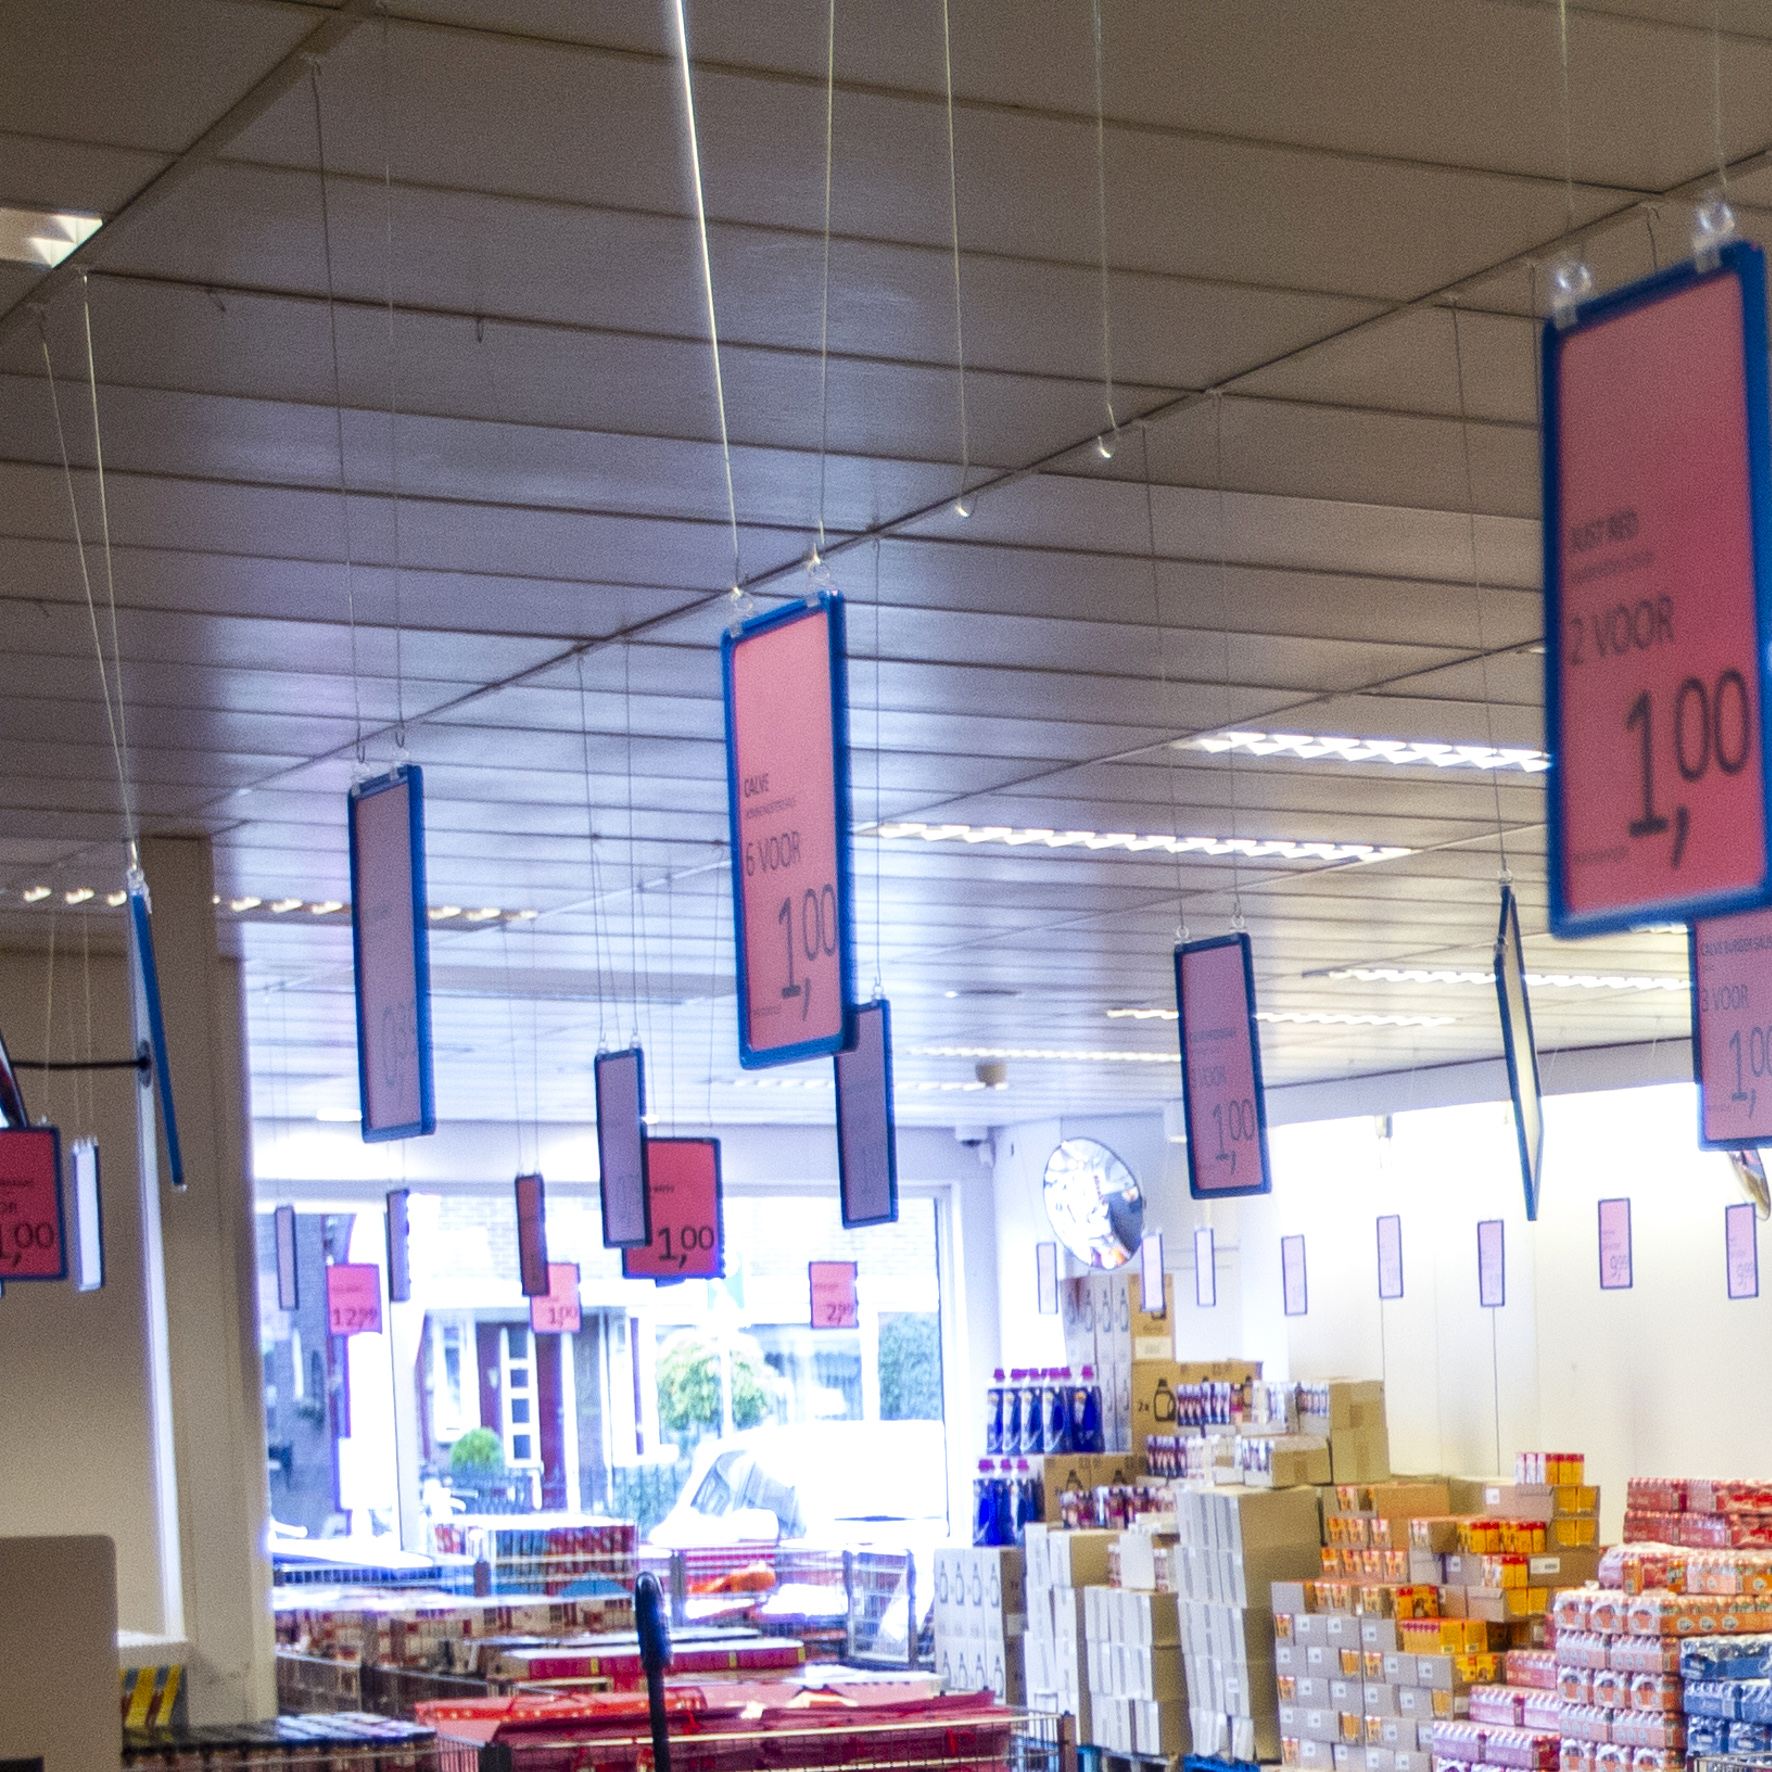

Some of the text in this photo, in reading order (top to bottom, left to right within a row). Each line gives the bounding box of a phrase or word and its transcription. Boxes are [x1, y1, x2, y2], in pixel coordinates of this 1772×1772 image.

[1569, 594, 1674, 666] 2 VOOR
[1626, 668, 1751, 869] 1,00
[746, 831, 800, 877] 6 VOOR
[778, 884, 837, 1021] 1,00
[1712, 984, 1749, 1010] VOOR
[1213, 1099, 1256, 1176] 1,00
[657, 1225, 715, 1269] 1,00
